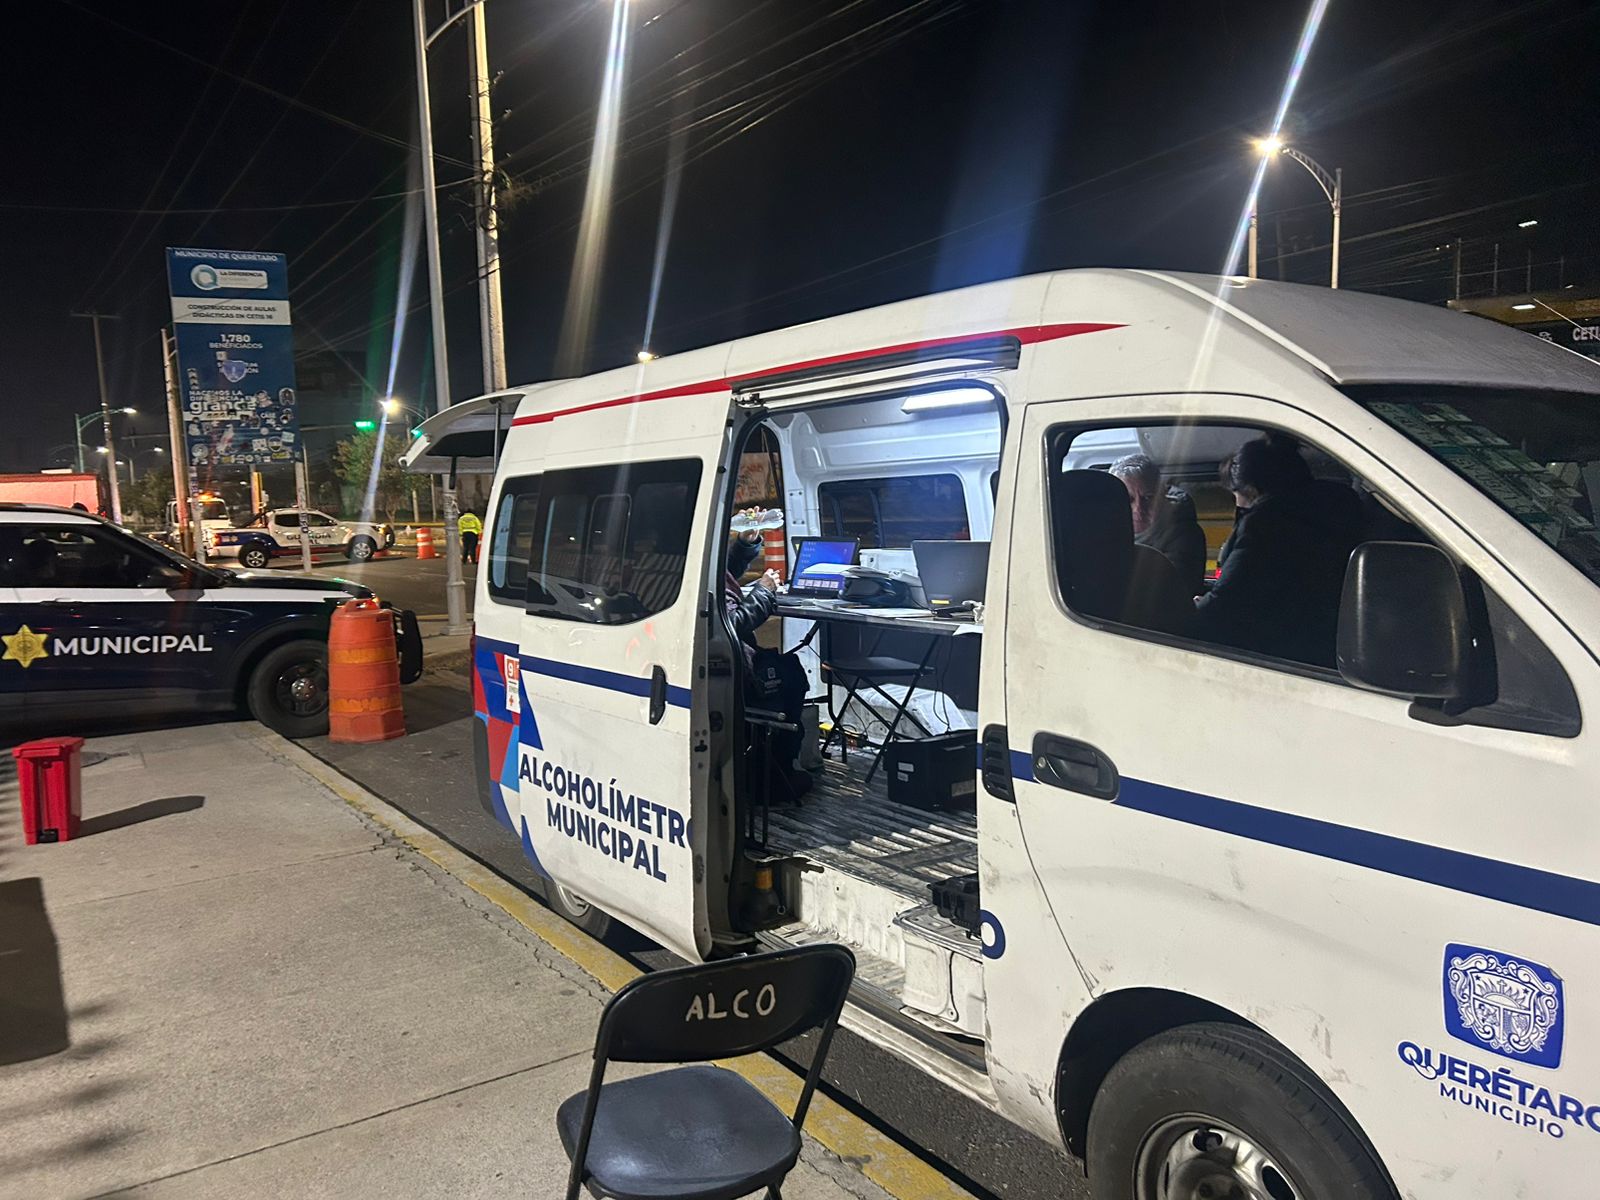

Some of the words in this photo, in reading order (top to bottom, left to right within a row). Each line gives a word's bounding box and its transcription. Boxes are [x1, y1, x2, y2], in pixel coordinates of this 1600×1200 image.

[175, 250, 217, 259] MUNICIPIO
[219, 252, 230, 260] DE
[220, 334, 251, 344] 1,780
[1572, 326, 1600, 341] CETI
[53, 634, 213, 656] MUNICIPAL
[519, 753, 692, 850] ALCOHOLÍMETR
[547, 798, 667, 883] MUNICIPAL
[685, 983, 776, 1022] ALCO
[1440, 1082, 1564, 1138] MUNICIPIO
